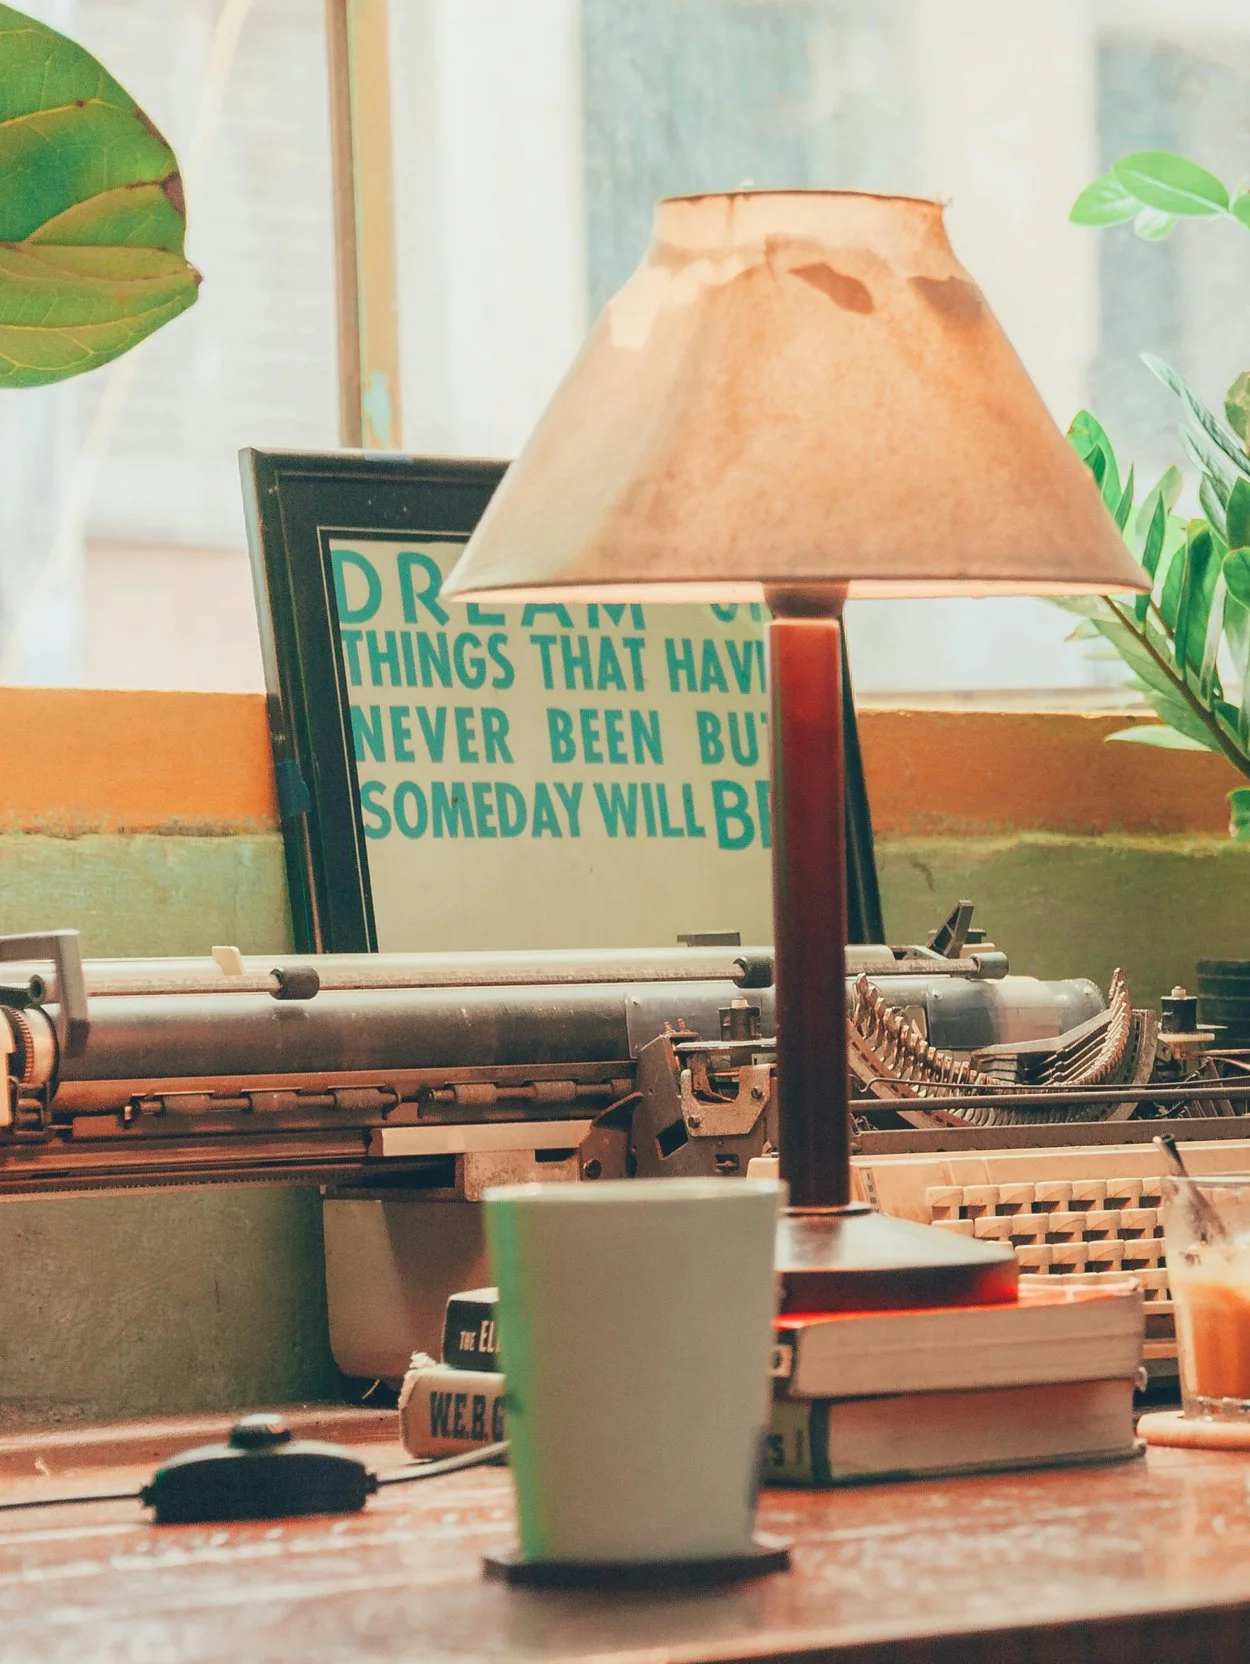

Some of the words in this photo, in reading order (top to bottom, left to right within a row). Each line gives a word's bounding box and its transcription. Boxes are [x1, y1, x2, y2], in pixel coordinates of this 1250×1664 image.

[341, 629, 515, 690] THINGS
[529, 634, 645, 691] THAT
[350, 705, 514, 764] NEVER
[546, 708, 664, 765] BEEN
[696, 710, 768, 767] BU
[360, 780, 583, 840] SOMEDAY
[593, 782, 705, 838] WILL
